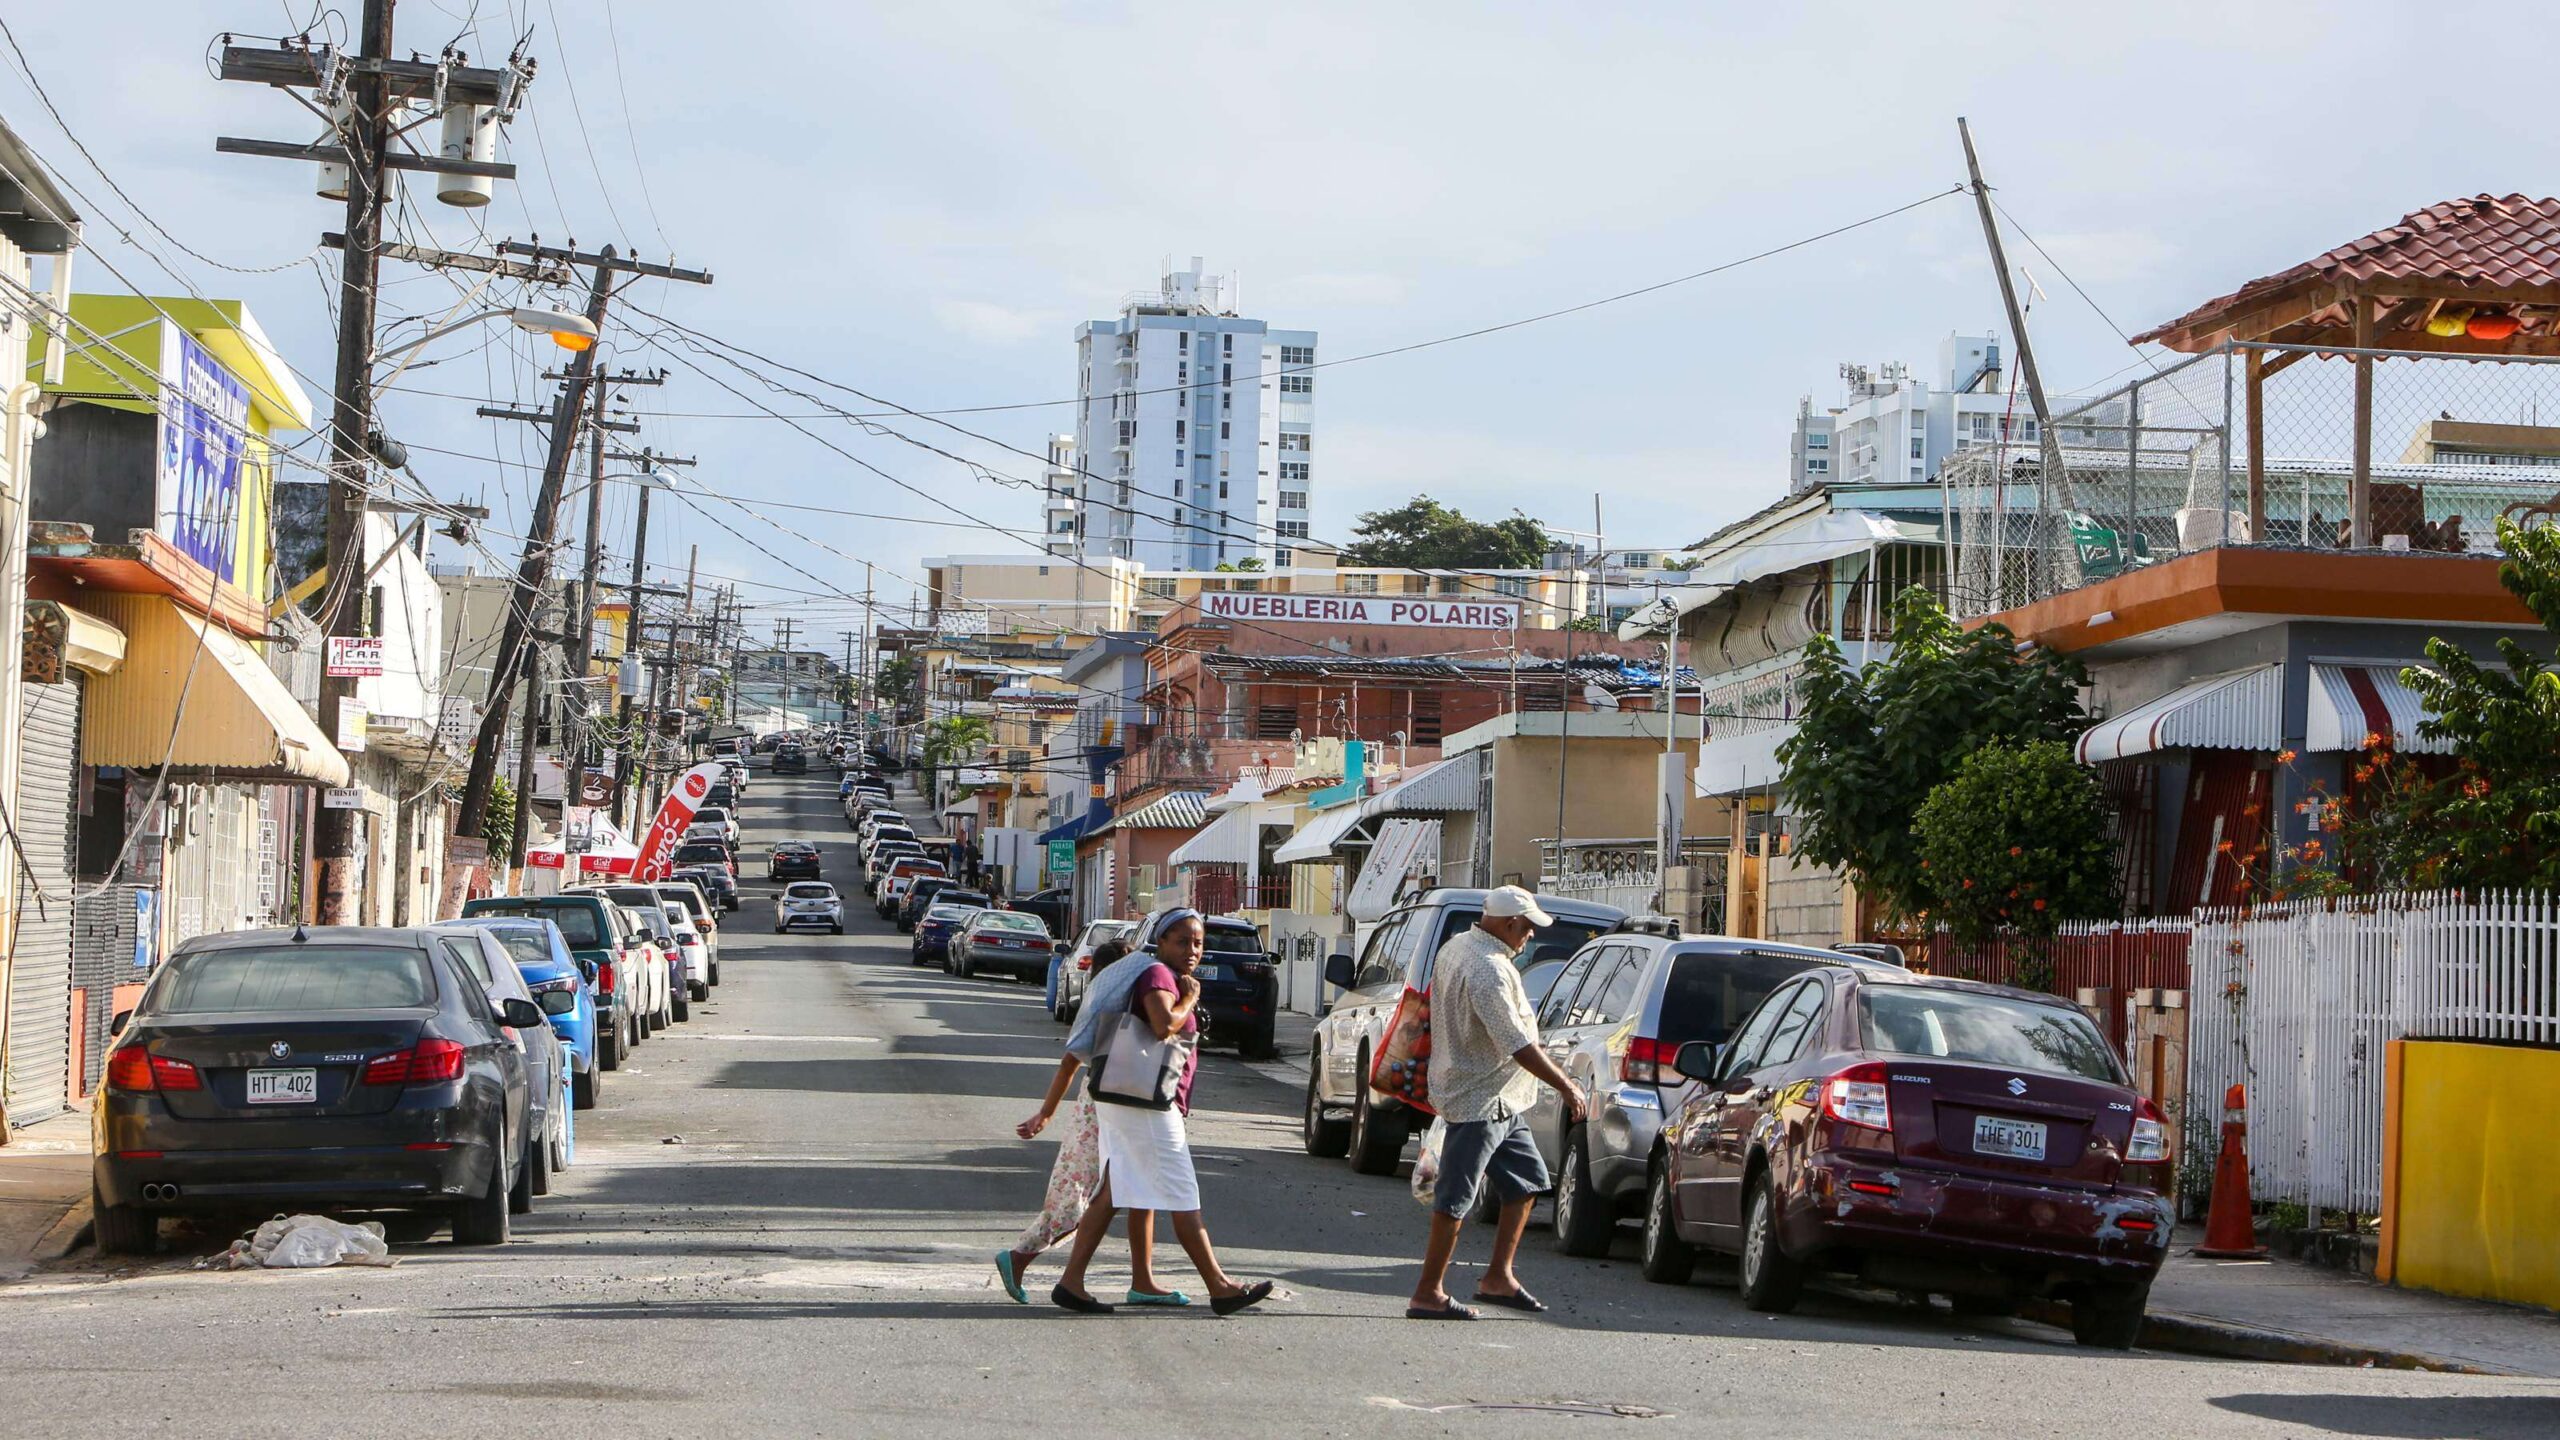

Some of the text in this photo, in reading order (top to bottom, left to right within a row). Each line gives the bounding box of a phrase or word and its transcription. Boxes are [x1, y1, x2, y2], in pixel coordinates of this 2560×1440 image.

[1211, 596, 1508, 626] MUEBLERIA POLARIS
[687, 778, 702, 792] Claro
[329, 789, 358, 797] CRISTO
[643, 828, 677, 882] Claro
[252, 1076, 312, 1093] HTT 402
[1892, 1074, 1931, 1083] SUZUKI
[2108, 1102, 2133, 1112] SX4
[1980, 1124, 2040, 1149] IHE 301
